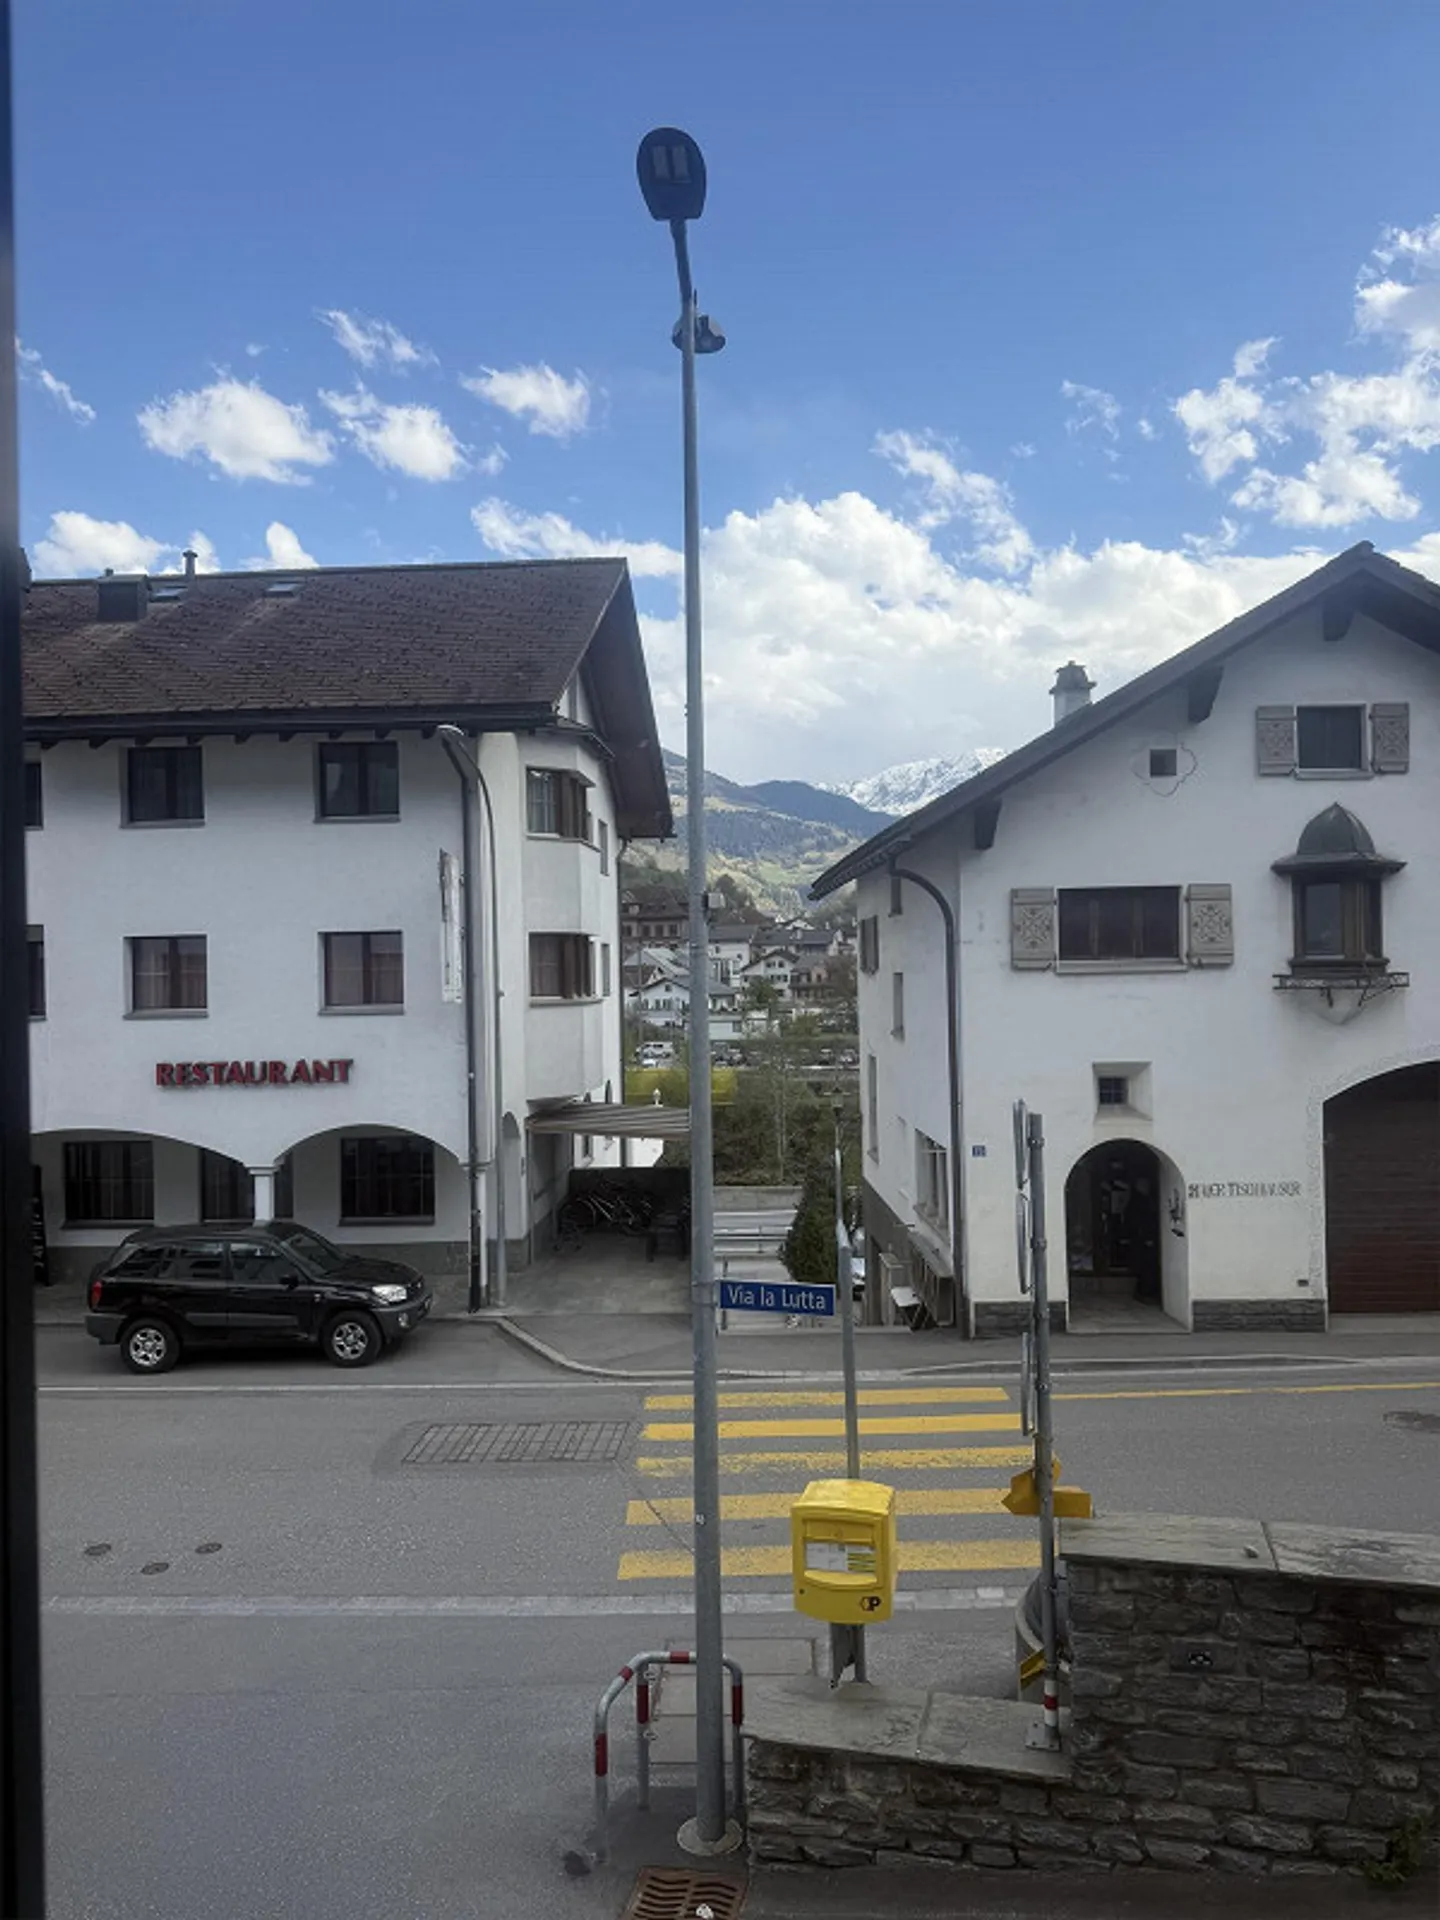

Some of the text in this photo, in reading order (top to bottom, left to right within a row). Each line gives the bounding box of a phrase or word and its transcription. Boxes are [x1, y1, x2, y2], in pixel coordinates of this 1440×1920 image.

[156, 1059, 354, 1086] RESTAURANT
[728, 1285, 826, 1309] Via la Lutta
